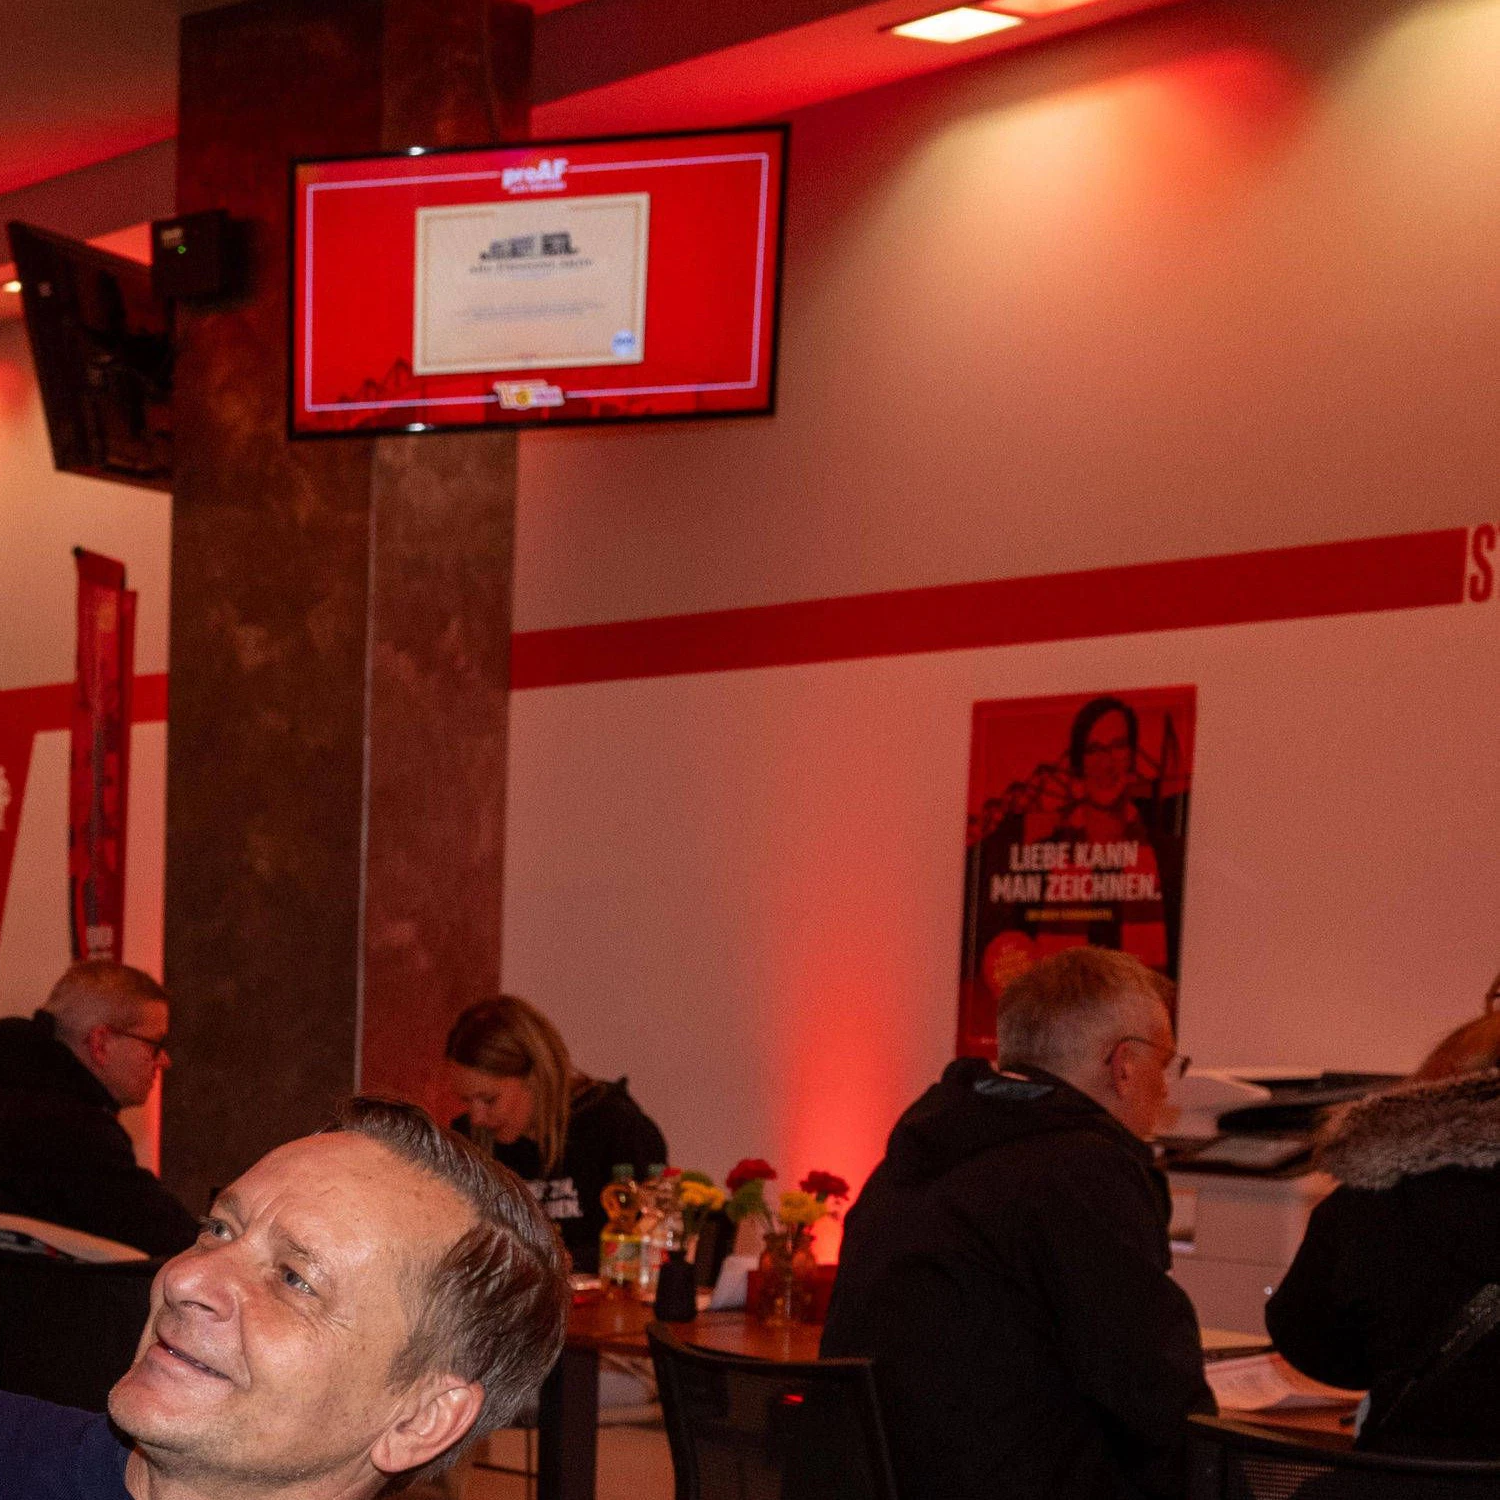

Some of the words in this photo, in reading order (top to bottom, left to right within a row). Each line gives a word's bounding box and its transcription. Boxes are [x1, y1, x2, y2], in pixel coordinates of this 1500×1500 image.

[1469, 523, 1500, 602] S
[1009, 842, 1070, 871] LIEBE
[1074, 840, 1139, 869] KANN
[990, 874, 1042, 903] MAN
[1045, 873, 1162, 902] ZEICHNEN.
